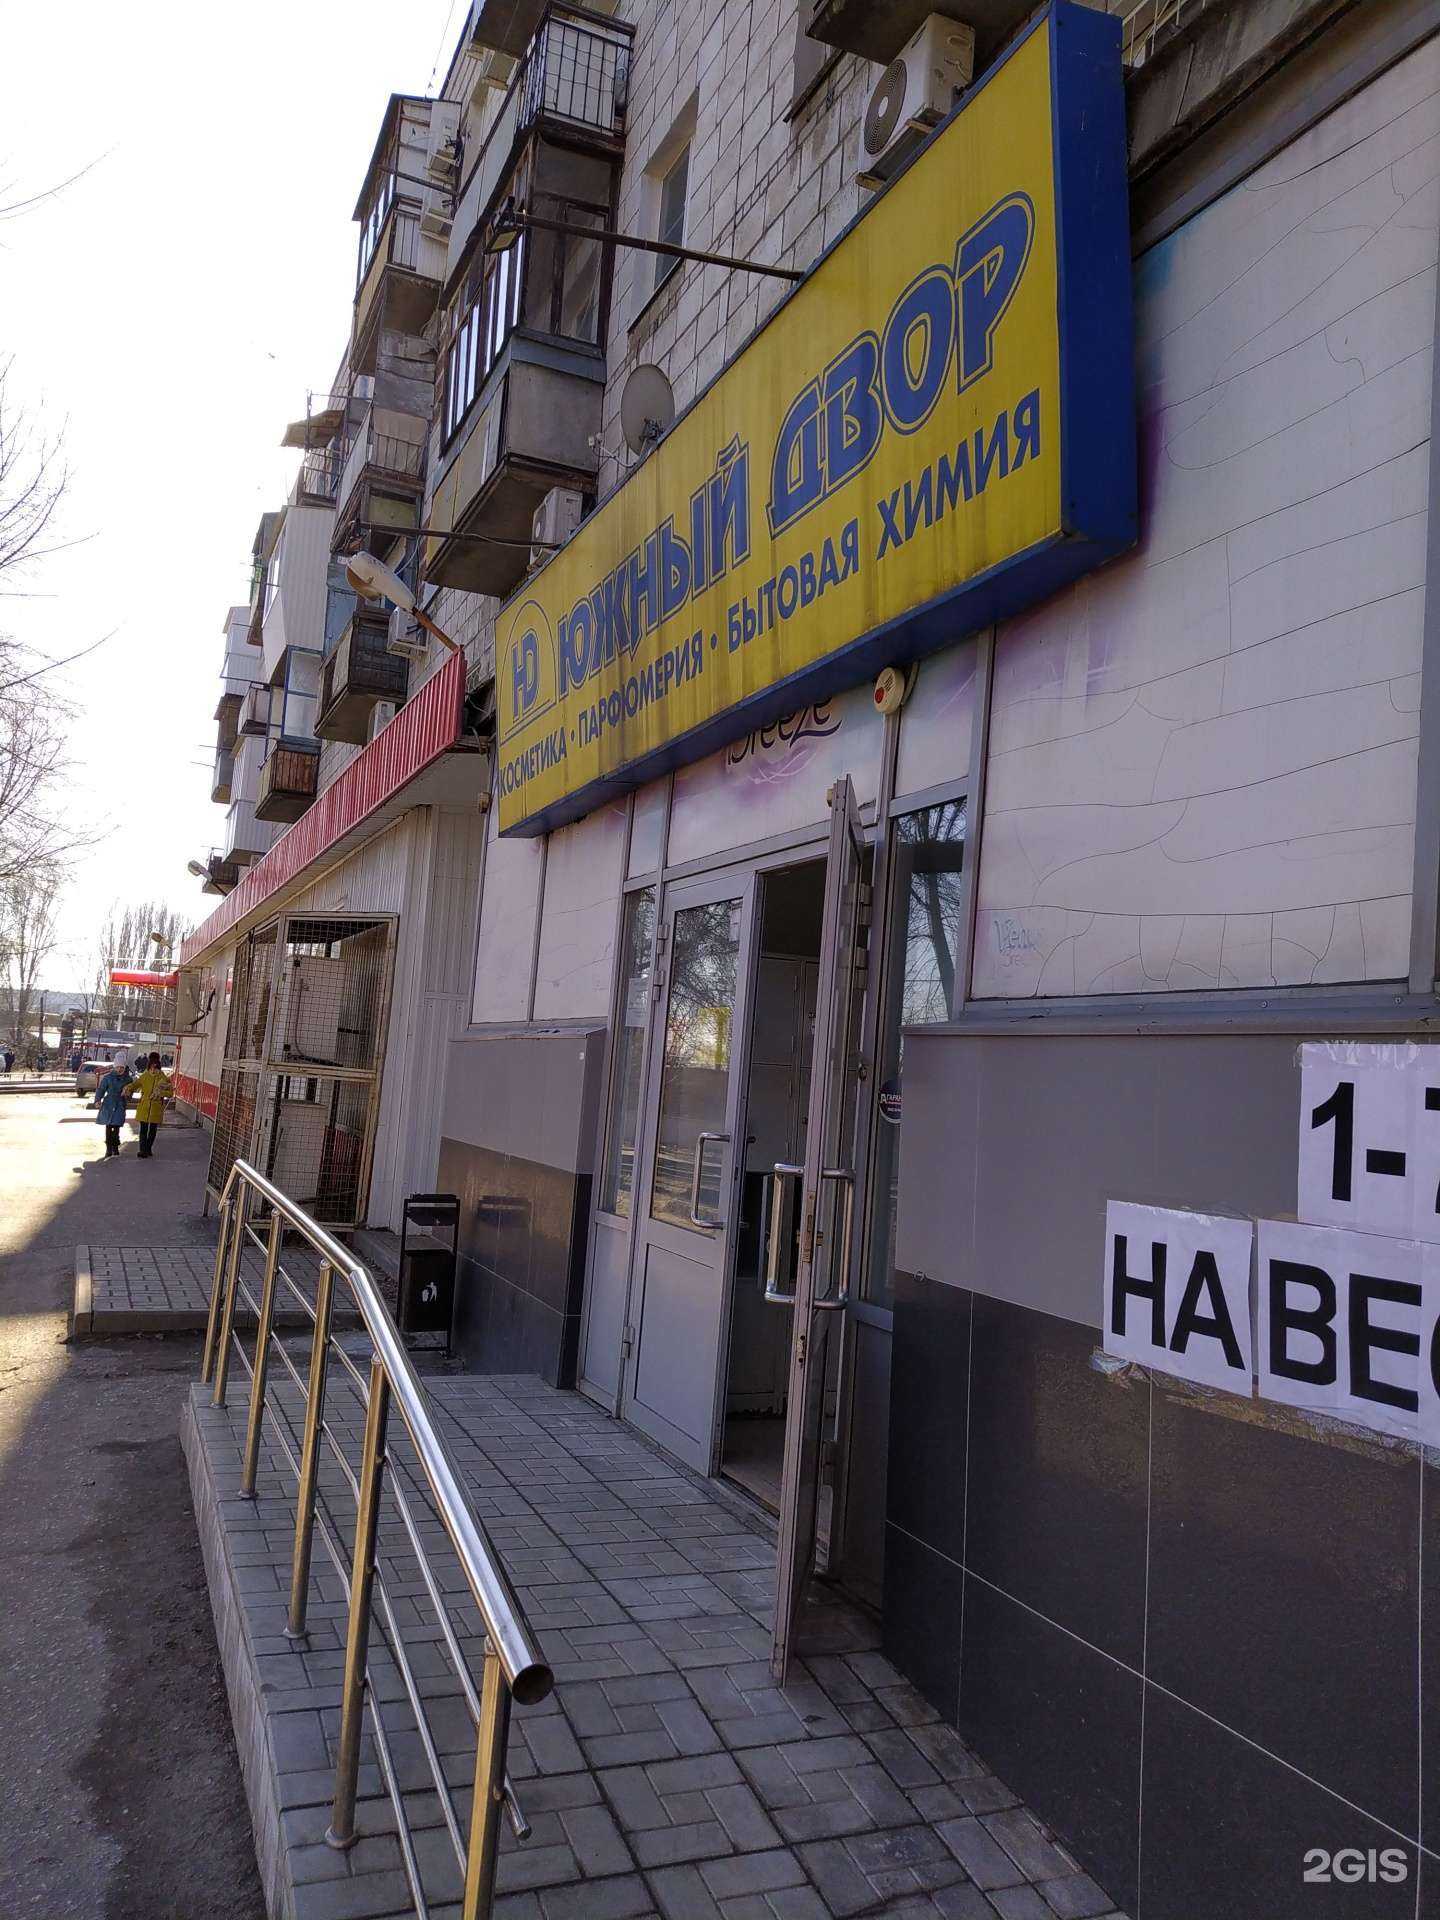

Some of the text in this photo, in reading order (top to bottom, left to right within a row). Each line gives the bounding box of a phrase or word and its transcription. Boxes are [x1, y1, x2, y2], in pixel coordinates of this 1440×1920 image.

[499, 388, 1041, 798] КОСМЕТИКА ПАРФЮМЕРИЯ БЫТОВАЯ ХИМИЯ
[557, 191, 1036, 702] ЮЖНЫЙ ДВОР
